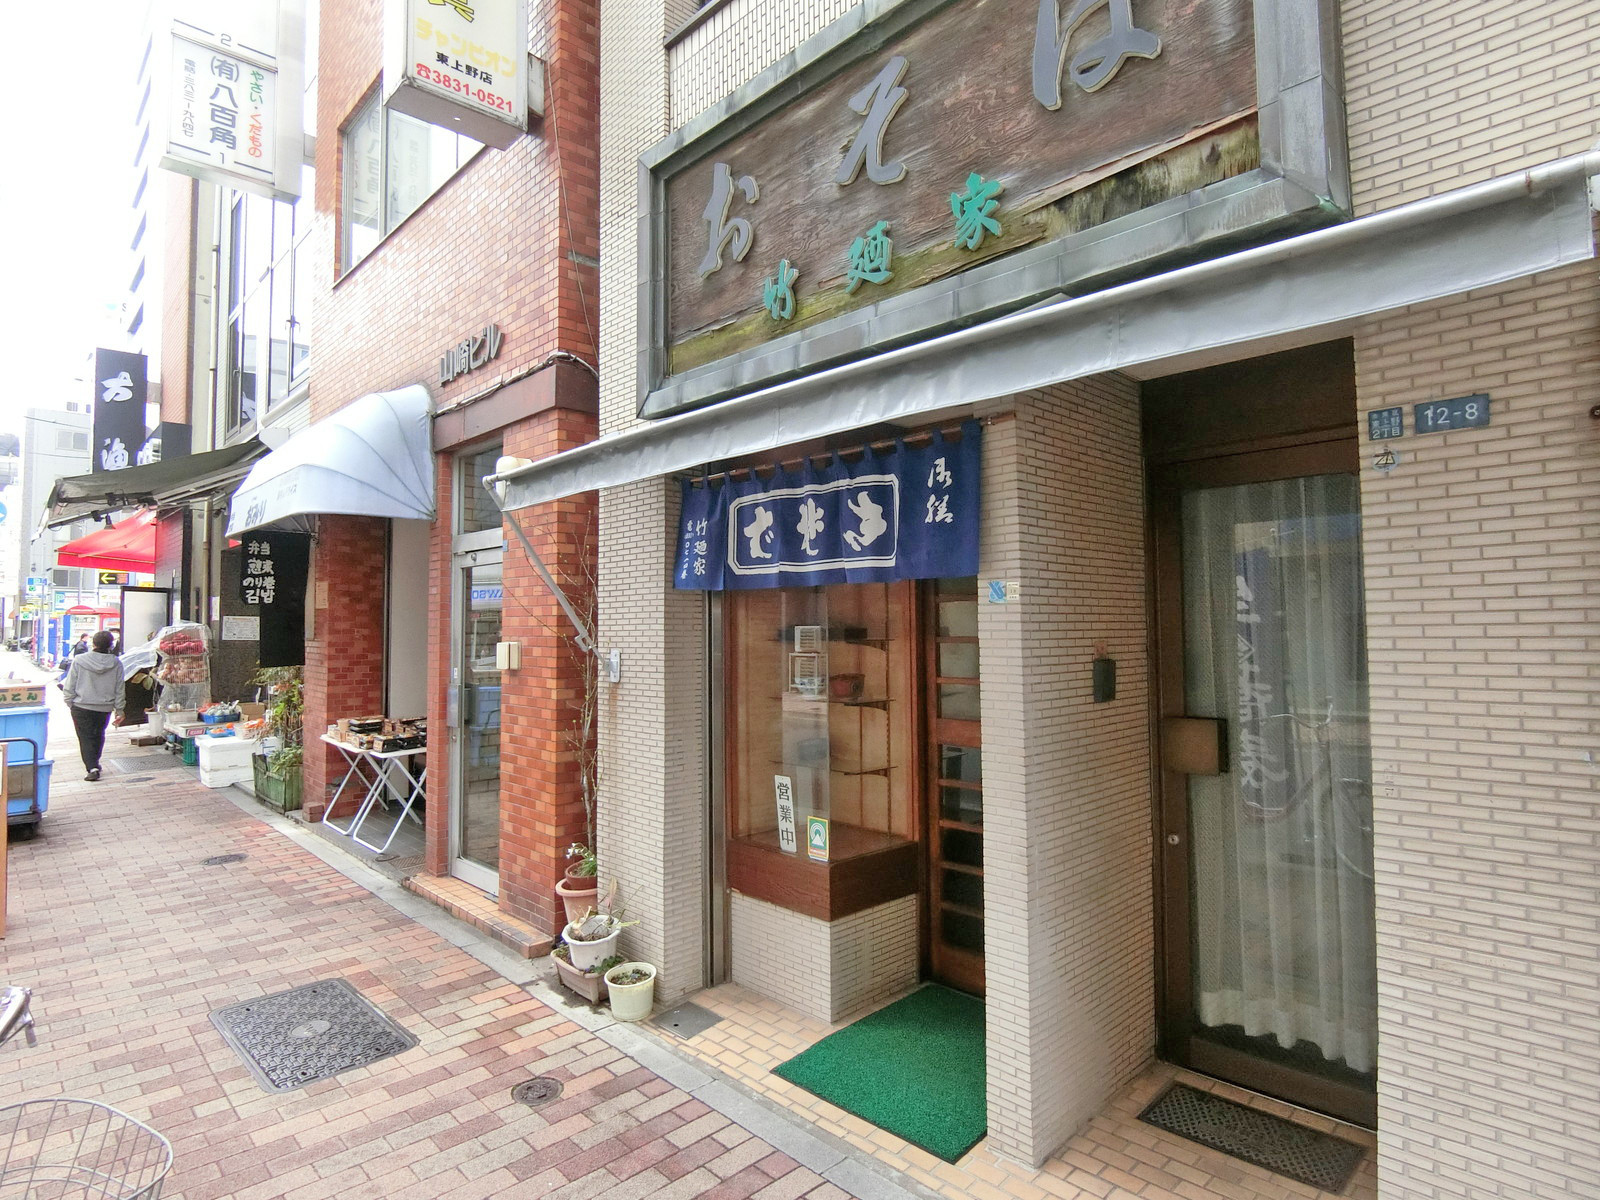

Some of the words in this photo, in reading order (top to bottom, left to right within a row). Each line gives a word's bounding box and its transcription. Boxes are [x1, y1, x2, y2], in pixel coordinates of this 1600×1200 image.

[415, 18, 516, 77] チャンピオン
[436, 51, 493, 85] 東上野店
[432, 70, 513, 113] 3831-0521
[1424, 403, 1478, 426] 12-8
[1373, 427, 1400, 439] 2丁目
[248, 540, 271, 555] 弁当
[243, 576, 275, 590] のり巻
[245, 588, 275, 604] 김밥
[776, 782, 796, 845] 営業中
